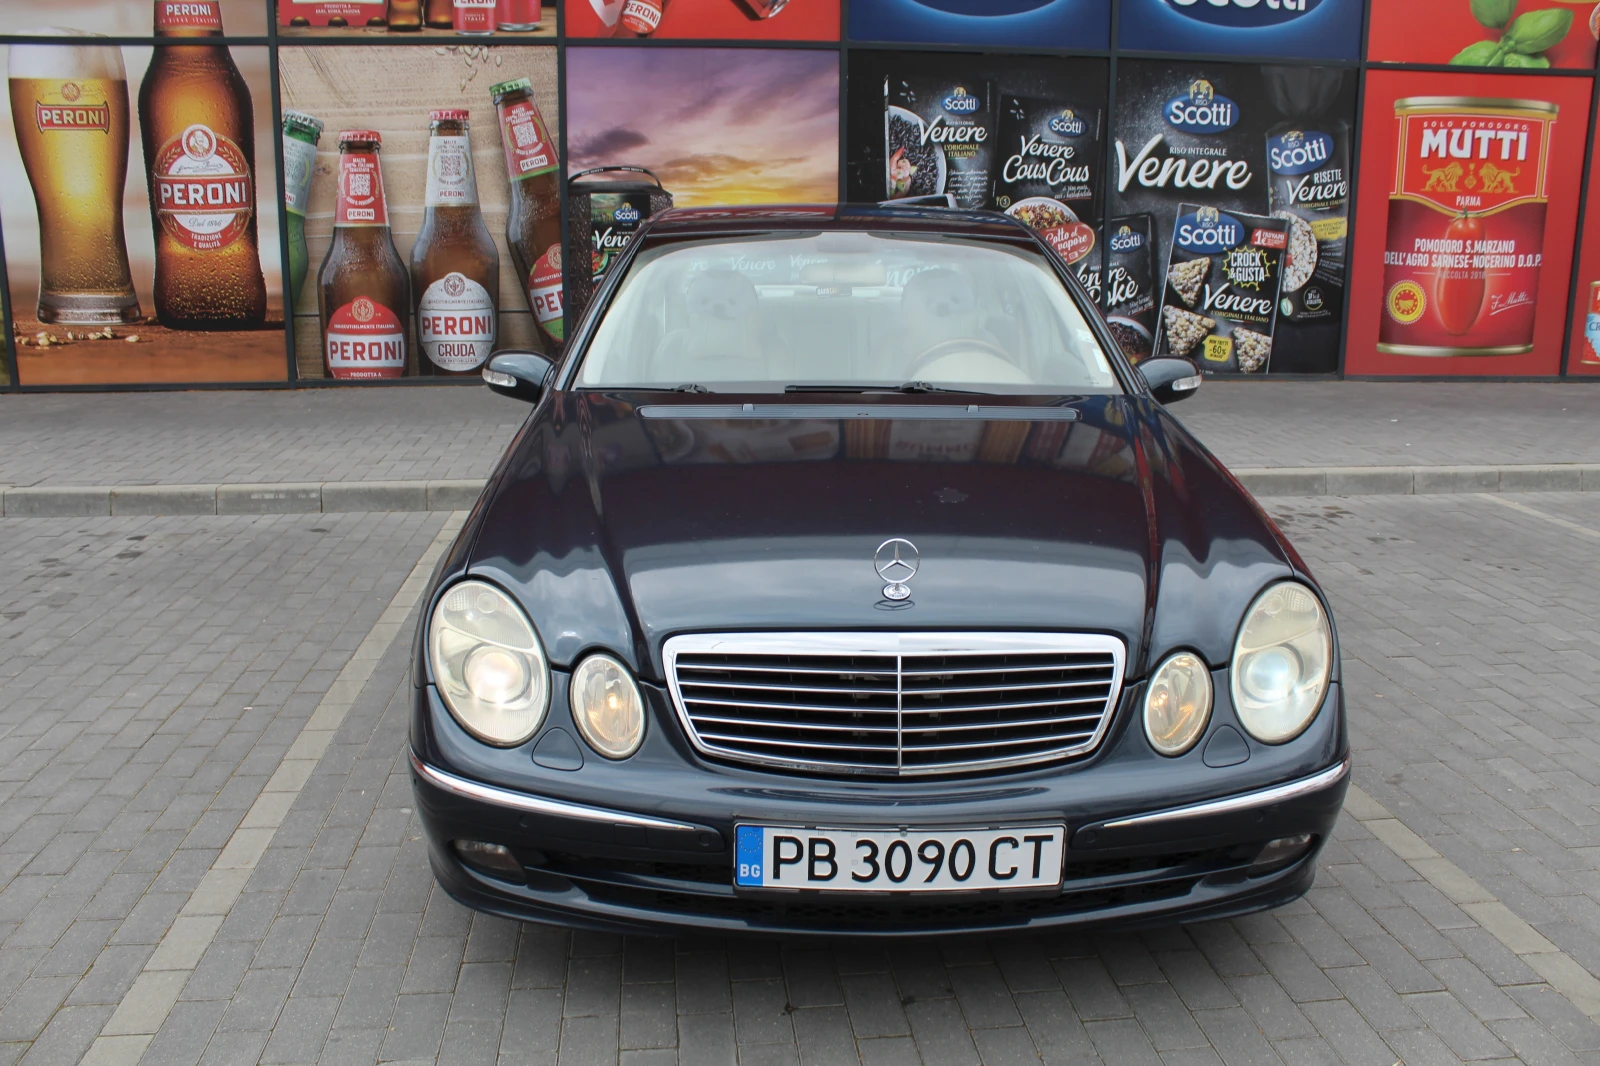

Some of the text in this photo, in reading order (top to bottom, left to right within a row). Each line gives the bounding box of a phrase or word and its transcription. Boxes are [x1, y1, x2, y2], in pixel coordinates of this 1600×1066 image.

[166, 4, 211, 16] PERONI
[625, 2, 659, 25] PERONI
[945, 98, 976, 111] Scotti
[41, 110, 104, 124] PERONI
[1169, 101, 1231, 126] Scotti
[918, 114, 988, 146] Venere
[1051, 119, 1082, 134] Scotti
[1021, 133, 1075, 159] Venere
[1187, 147, 1227, 156] INTEGRALE
[1420, 128, 1528, 161] MUTTI
[1271, 137, 1327, 170] Scotti
[521, 156, 547, 170] PERONI
[1115, 133, 1252, 193] Venere
[1313, 168, 1342, 185] RISETTE
[160, 182, 247, 205] PERONI
[1286, 174, 1347, 205] Venere
[1455, 195, 1481, 207] PARMA
[348, 210, 374, 218] PERONI
[615, 210, 638, 220] Scotti
[191, 232, 222, 241] TRADIZIONE
[1045, 226, 1078, 246] Cotto al
[1057, 234, 1088, 251] vapore
[1111, 234, 1141, 250] Scotti
[1178, 224, 1236, 246] Scotti
[1414, 238, 1463, 253] POMODORO
[1230, 252, 1262, 267] CROCK
[1384, 251, 1542, 268] DELL'AGRO SARNESE-NOCERINO D.O.P.
[1440, 271, 1485, 279] RACCOLTA 2018
[1203, 282, 1273, 315] Venere
[422, 315, 491, 335] PERONI
[330, 340, 402, 361] PERONI
[438, 343, 476, 357] CRUDA
[772, 834, 1054, 883] PB 3090 CT
[739, 863, 761, 878] BG
